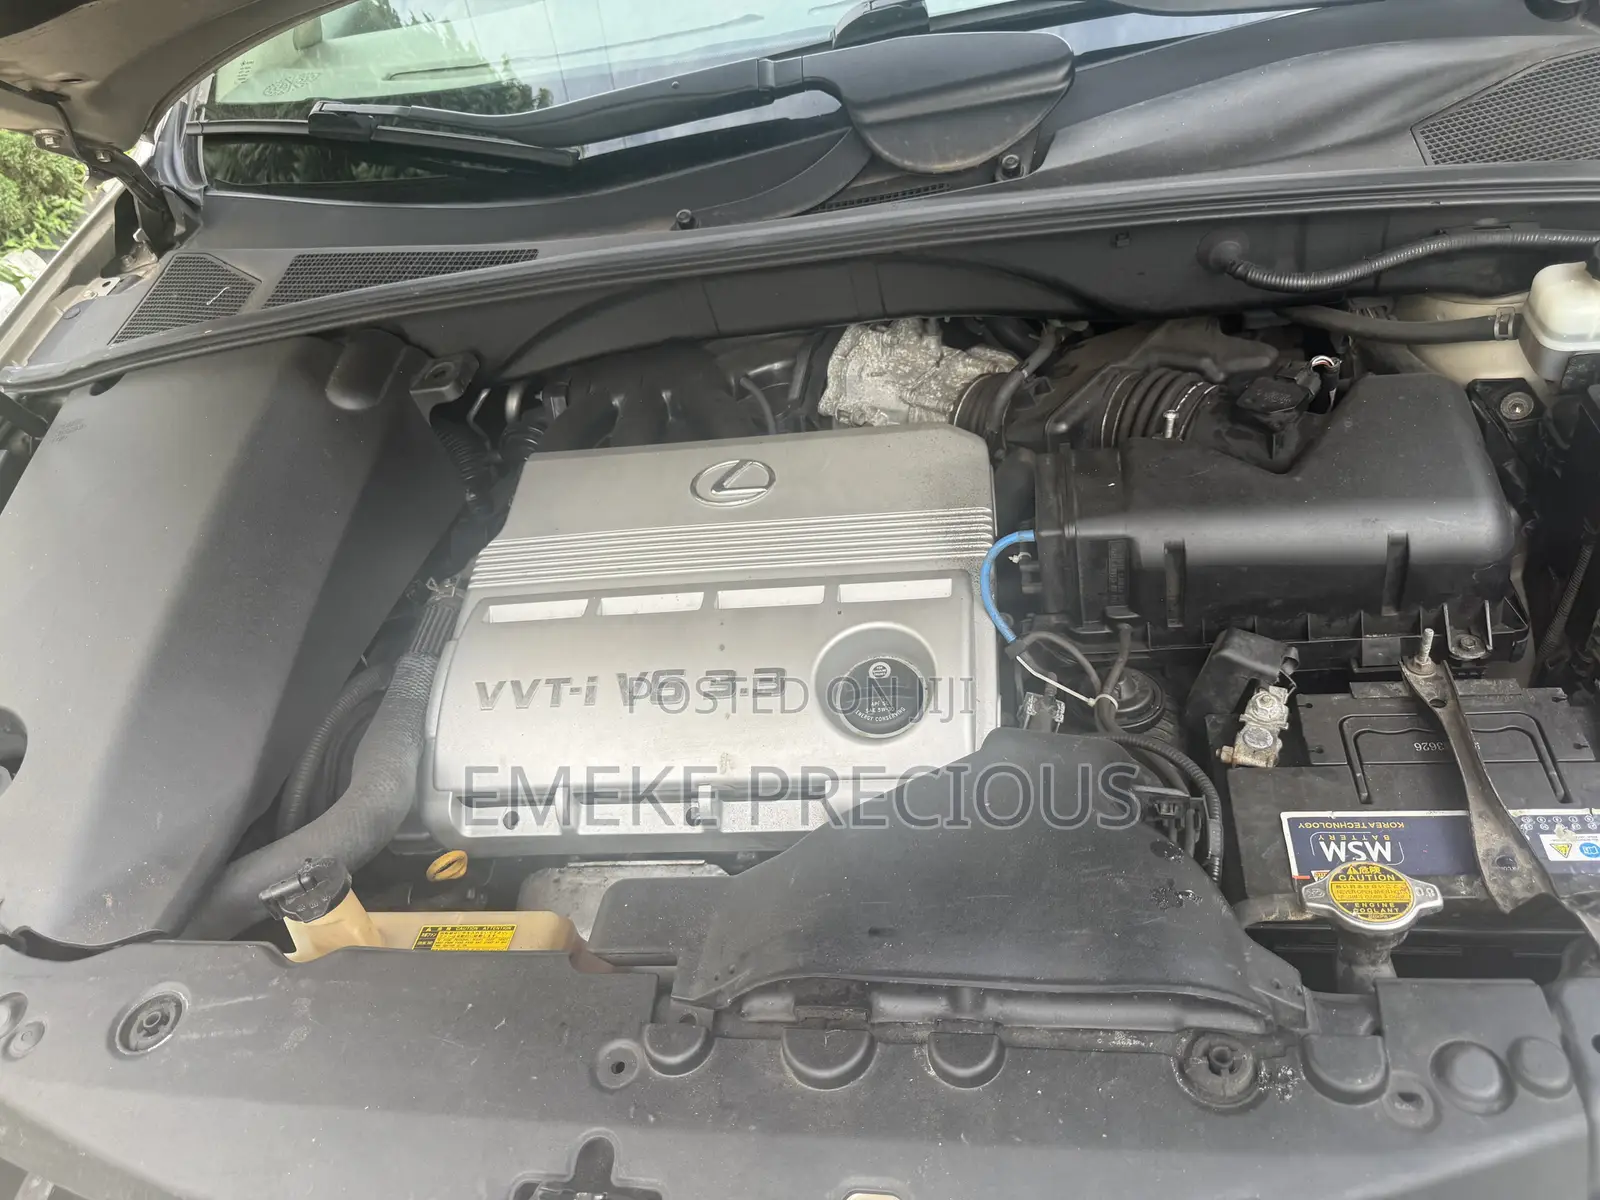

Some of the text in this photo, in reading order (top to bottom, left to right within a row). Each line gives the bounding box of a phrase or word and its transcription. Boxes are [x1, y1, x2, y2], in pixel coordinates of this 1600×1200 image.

[474, 667, 788, 711] VVT-i V6 3.3
[855, 706, 906, 722] ENERGY CONSERVING
[1298, 820, 1405, 830] KOREA TECHNOLOGY
[1318, 840, 1392, 862] MSM
